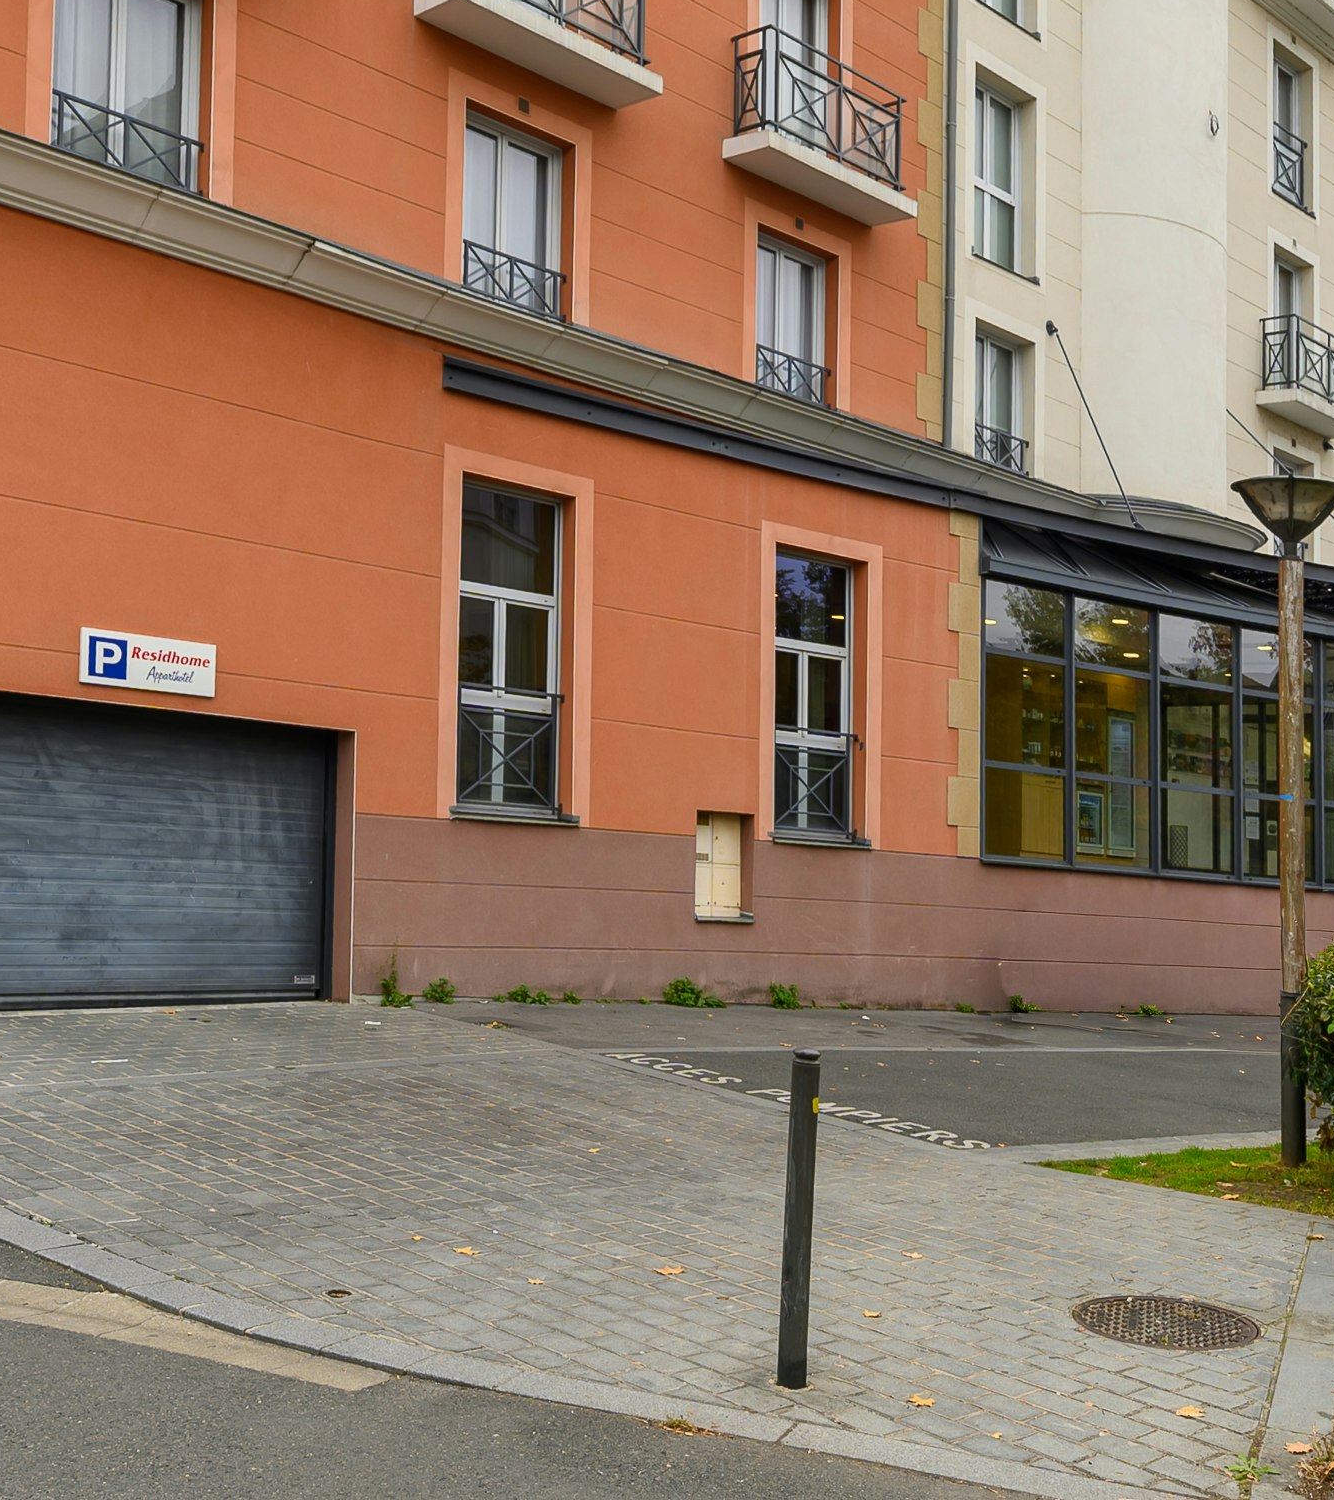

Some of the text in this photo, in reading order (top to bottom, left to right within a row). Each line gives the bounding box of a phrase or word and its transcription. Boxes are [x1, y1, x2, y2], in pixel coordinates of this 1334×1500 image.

[95, 640, 122, 674] P
[131, 646, 211, 668] Residhome
[146, 666, 195, 684] Apparthotel
[605, 1053, 742, 1084] ACCES
